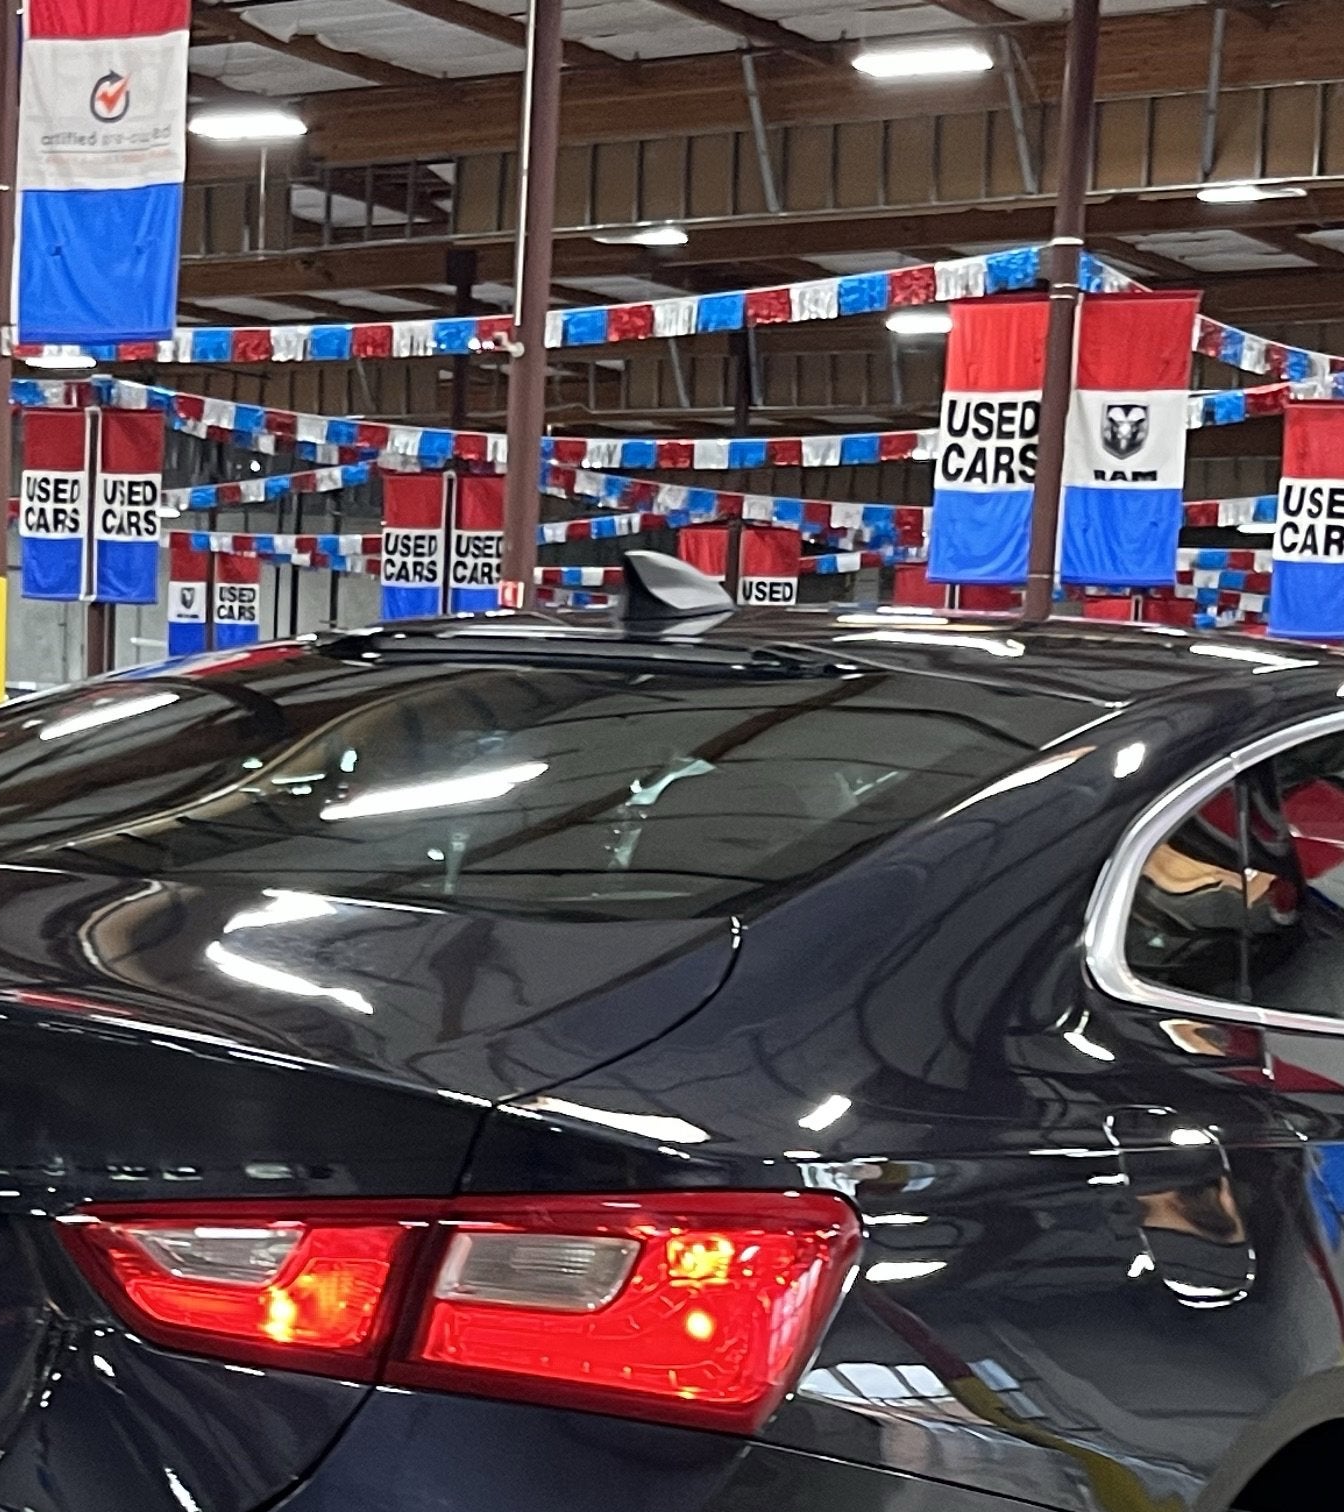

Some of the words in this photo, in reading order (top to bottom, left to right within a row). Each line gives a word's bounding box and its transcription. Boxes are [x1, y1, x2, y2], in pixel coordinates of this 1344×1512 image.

[947, 399, 1042, 441] USED
[941, 443, 1039, 484] CARS
[1093, 469, 1158, 482] RAM
[26, 476, 81, 504] USED
[103, 479, 158, 507] USED
[25, 506, 80, 533] CARS
[102, 508, 158, 536] CARS
[384, 532, 437, 557] USED
[384, 558, 438, 582] CARS
[219, 586, 256, 604] USED
[742, 581, 794, 602] USED
[217, 605, 256, 622] CARS
